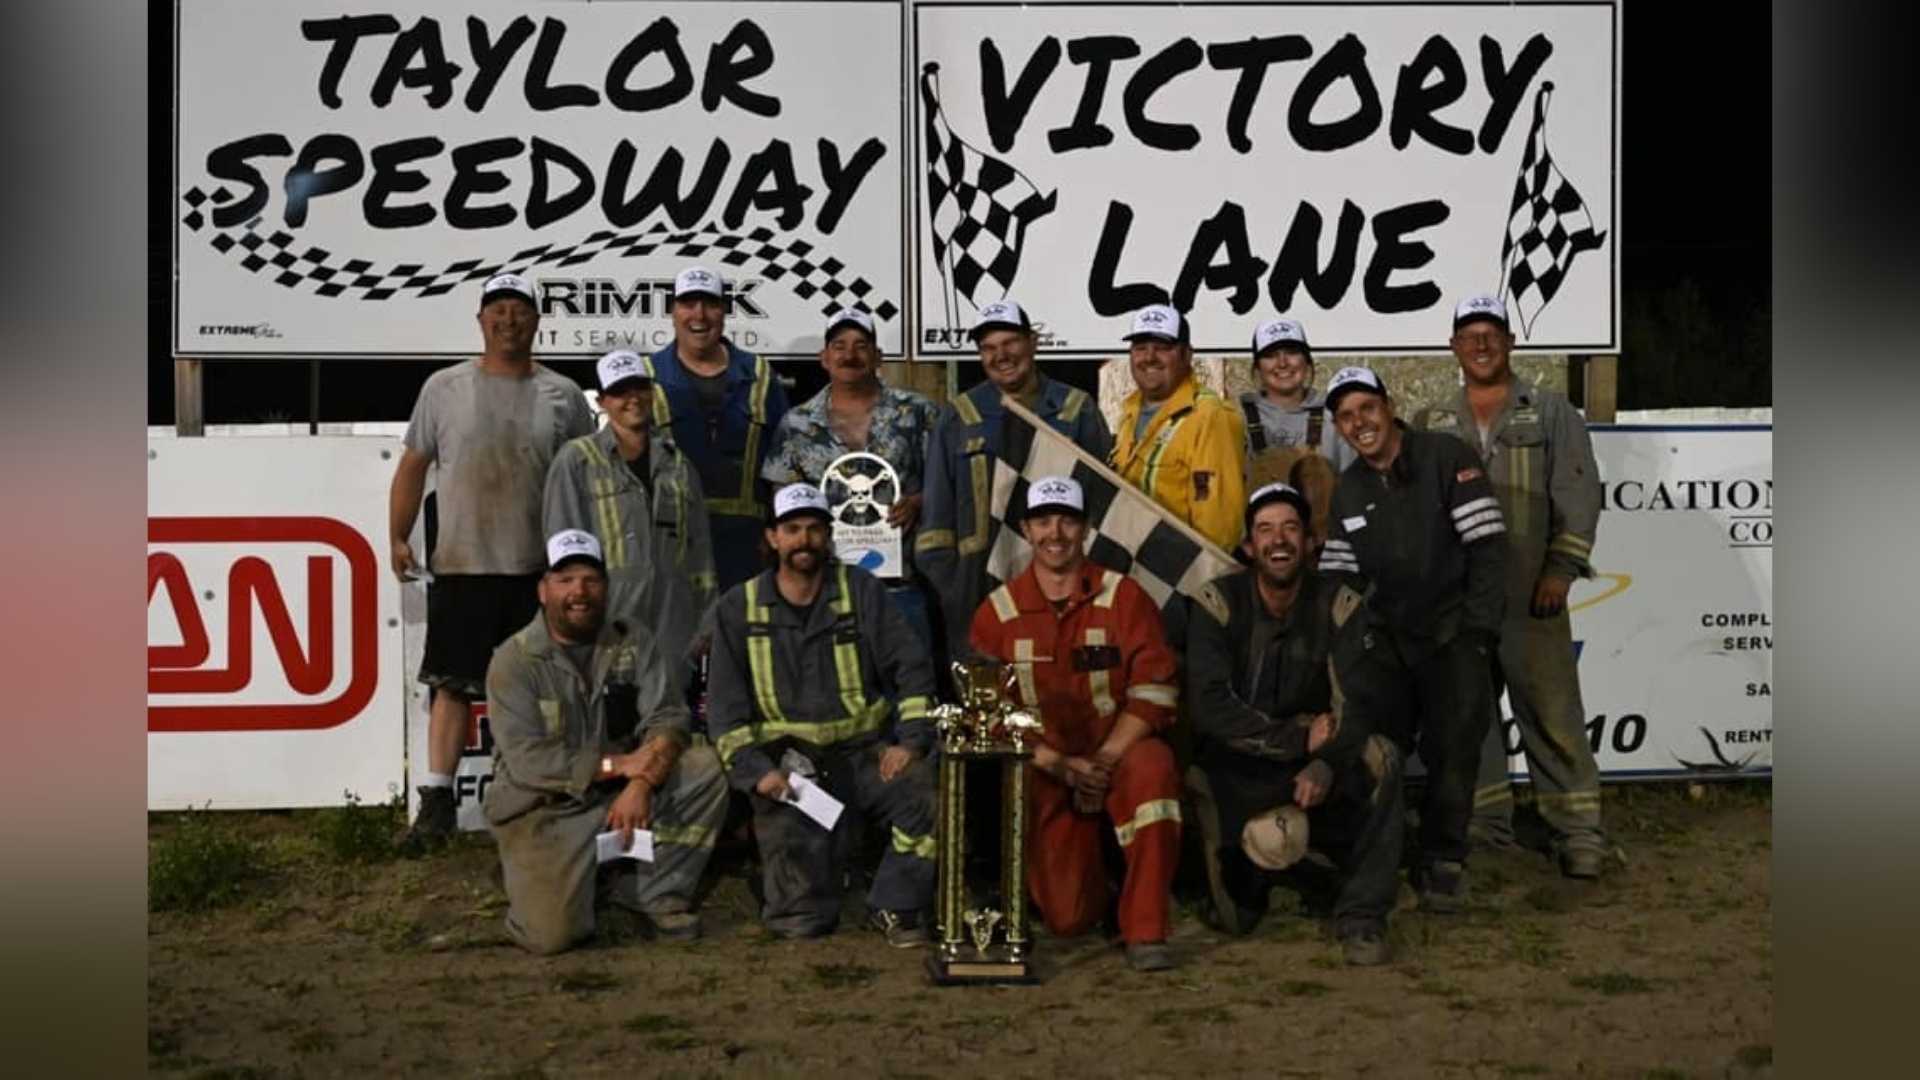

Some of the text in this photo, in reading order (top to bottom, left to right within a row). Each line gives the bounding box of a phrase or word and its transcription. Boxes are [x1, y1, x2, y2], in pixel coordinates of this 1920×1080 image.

[301, 14, 781, 117] TAYLOR
[980, 33, 1553, 154] VICTORY
[206, 133, 887, 235] SPEEDWAY
[1088, 199, 1450, 316] LANE
[540, 280, 769, 317] RIMTK
[1729, 521, 1772, 542] CO
[1701, 613, 1771, 627] COMPL
[1723, 636, 1772, 650] SERV
[1746, 682, 1771, 697] SA
[1724, 730, 1773, 744] RENT
